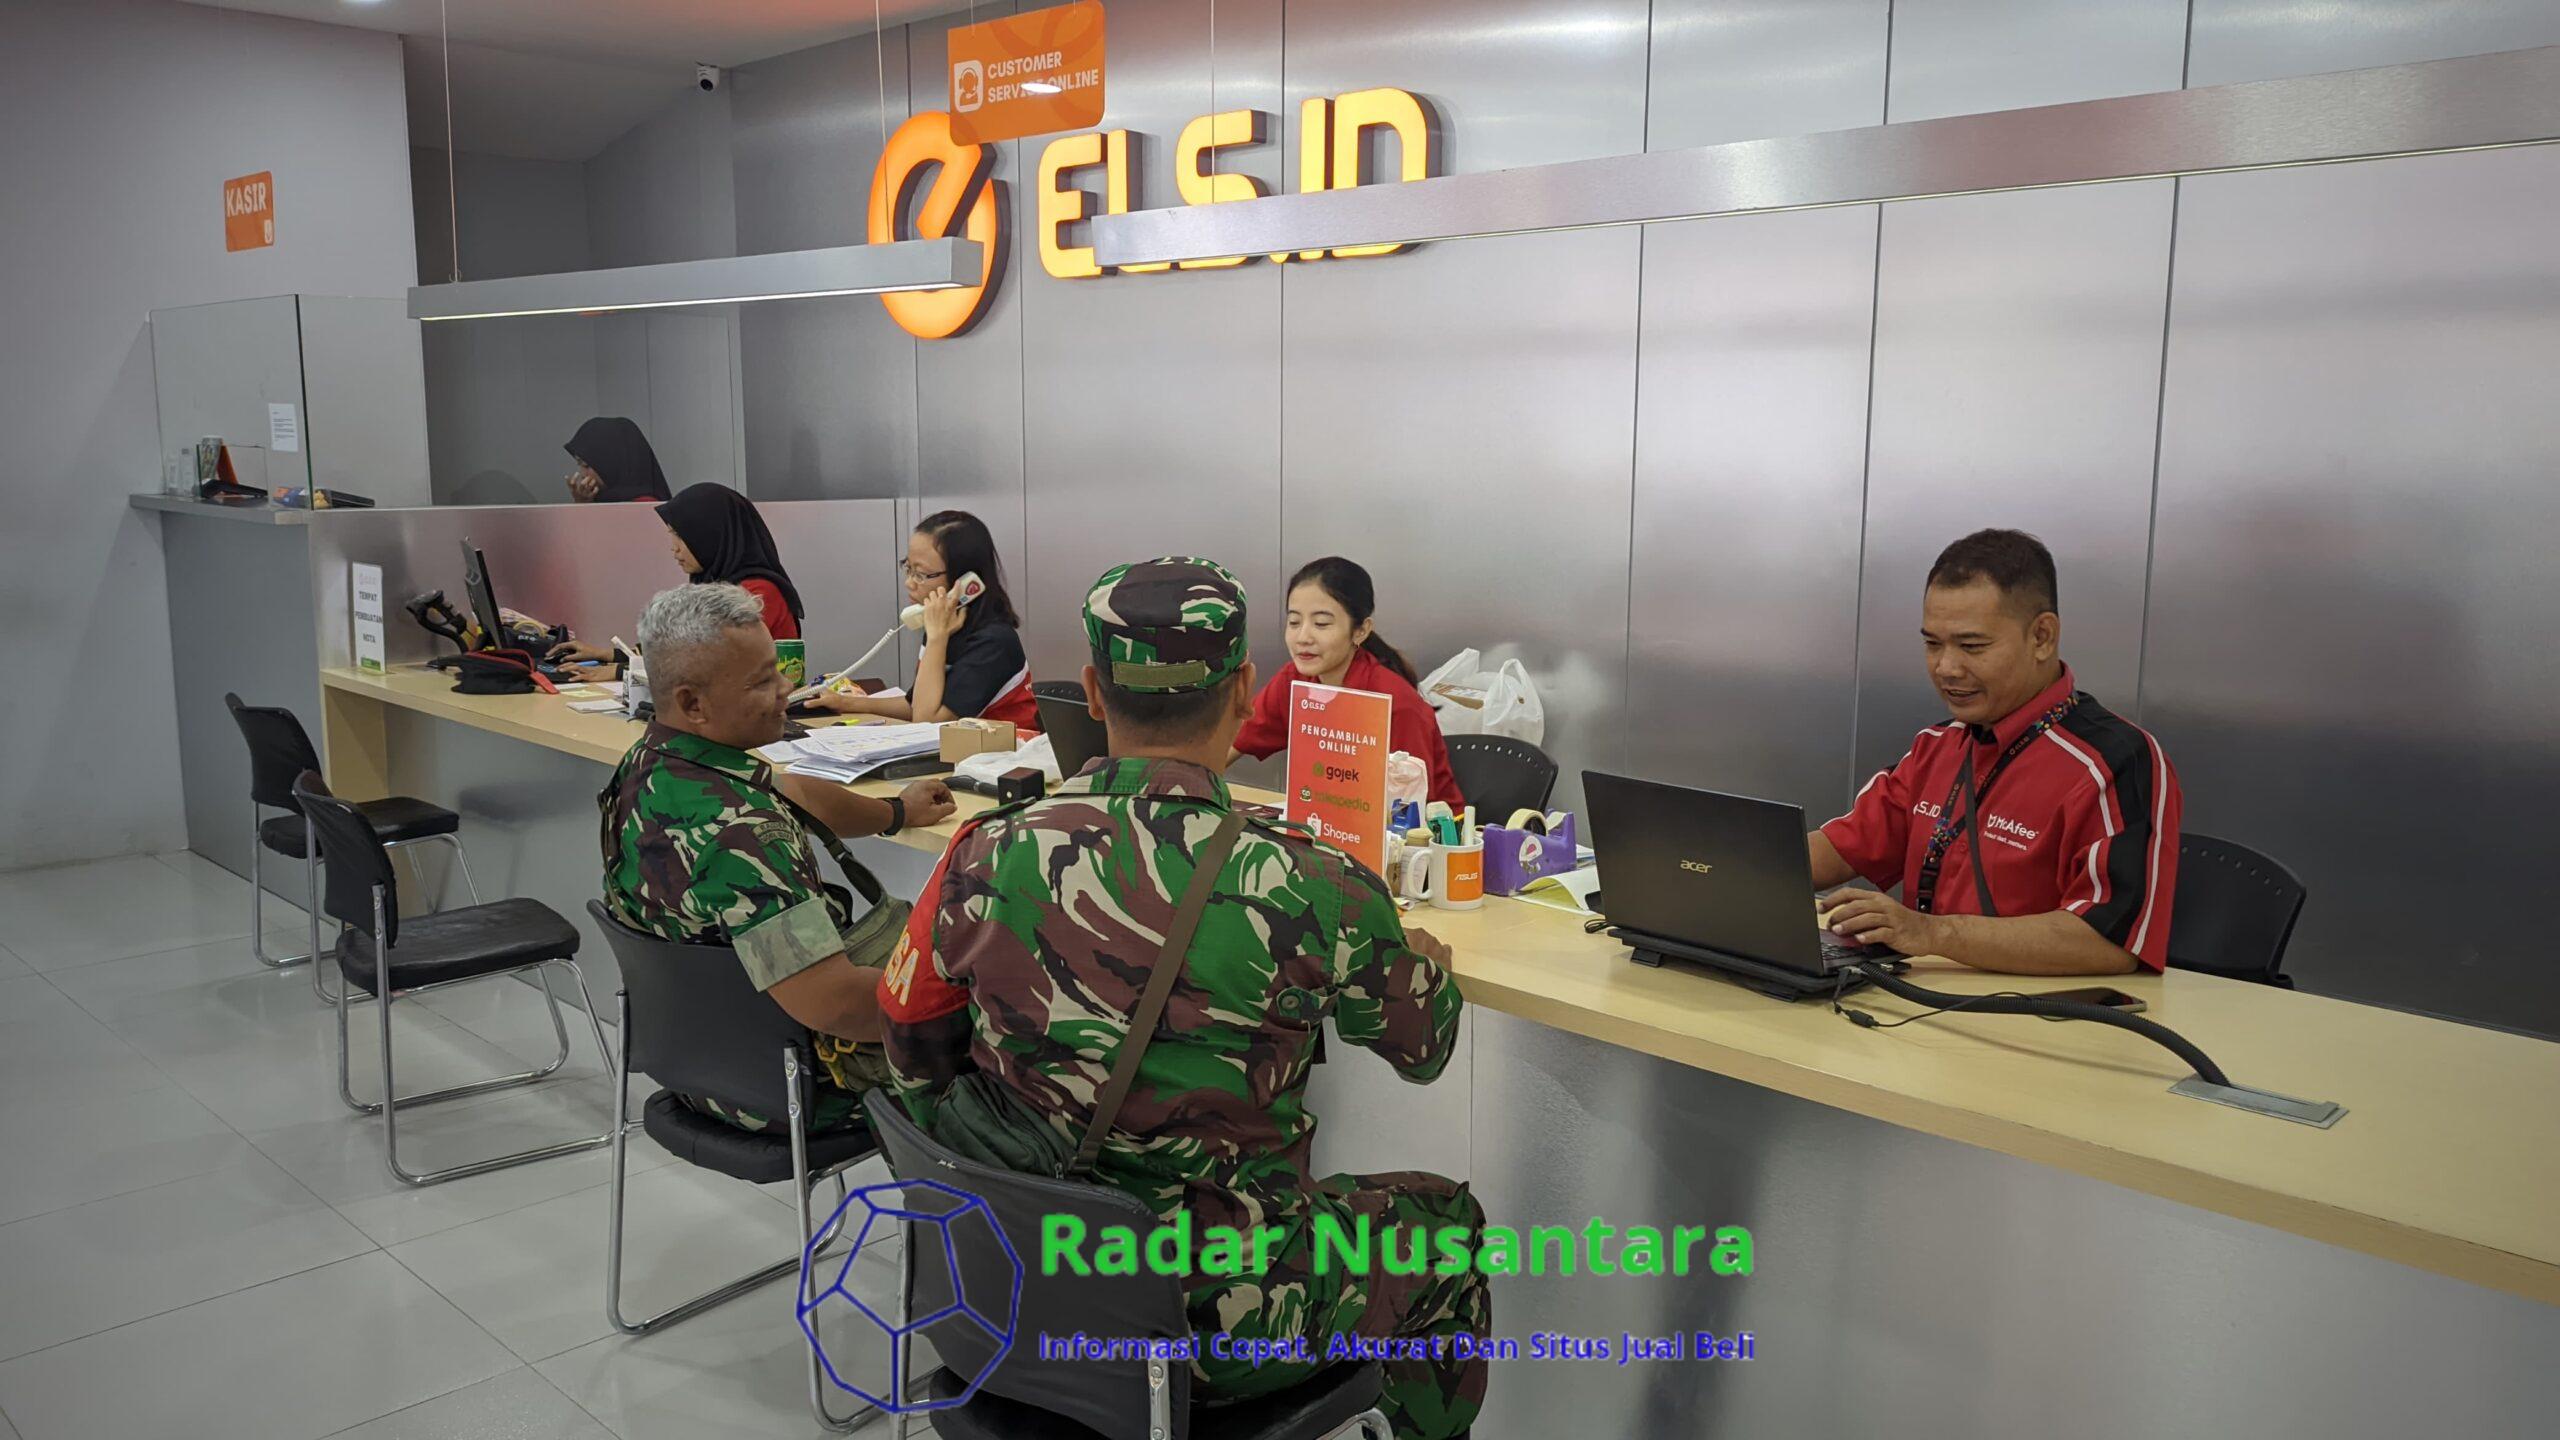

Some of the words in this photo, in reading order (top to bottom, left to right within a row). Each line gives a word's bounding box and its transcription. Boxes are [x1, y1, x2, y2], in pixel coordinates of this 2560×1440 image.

[987, 51, 1062, 79] CUSTOMER
[987, 79, 1045, 103] SERV
[226, 182, 267, 217] KASIR
[1301, 723, 1377, 746] PENGAMBILAN
[1318, 739, 1358, 756] ONLINE
[1326, 766, 1360, 783] gojek
[1323, 823, 1360, 844] Shopee
[1994, 815, 2036, 840] McAfee
[1680, 859, 1713, 873] acer
